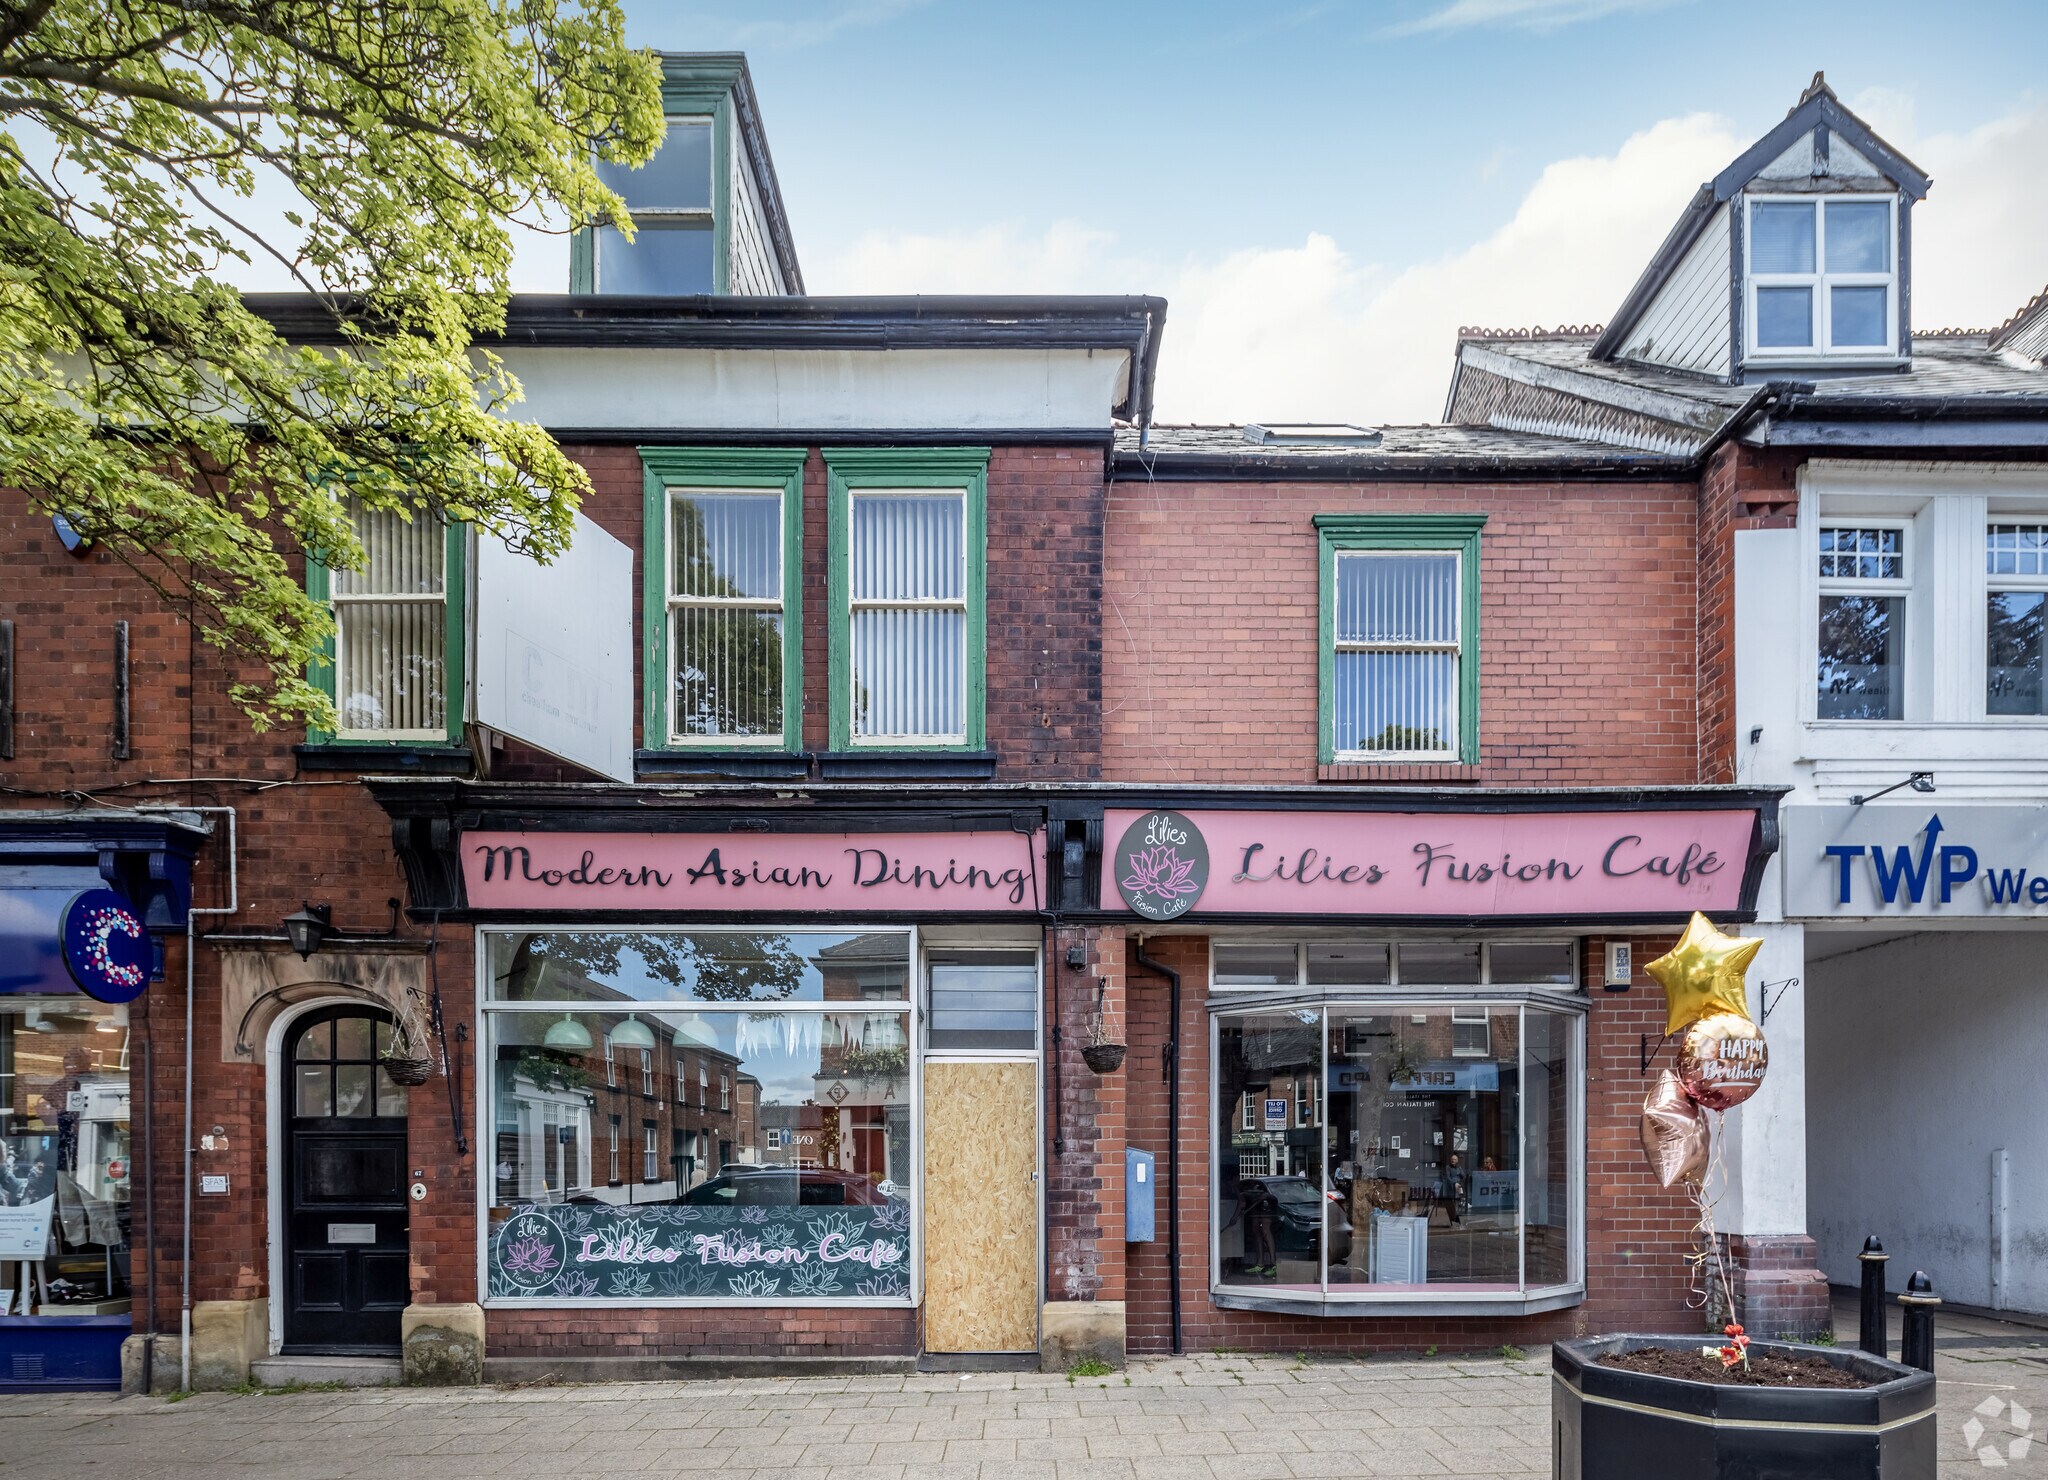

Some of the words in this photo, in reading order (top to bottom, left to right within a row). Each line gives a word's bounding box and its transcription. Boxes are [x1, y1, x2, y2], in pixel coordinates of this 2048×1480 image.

[1145, 815, 1187, 845] Lilies
[1232, 842, 1391, 885] Lilies
[1412, 842, 1584, 888] Fusion
[1601, 834, 1727, 886] Café
[1825, 812, 1979, 904] TWP
[1987, 868, 2048, 904] We
[474, 845, 673, 888] Modern
[687, 847, 833, 888] Asian
[843, 847, 1032, 904] Dining
[1132, 890, 1158, 914] Fusion
[1719, 1039, 1764, 1059] HAPPY
[1703, 1060, 1767, 1080] Birthday
[517, 1217, 548, 1237] Lilies
[576, 1233, 682, 1263] Lilies
[694, 1233, 809, 1265] Fusion
[818, 1233, 902, 1269] Café
